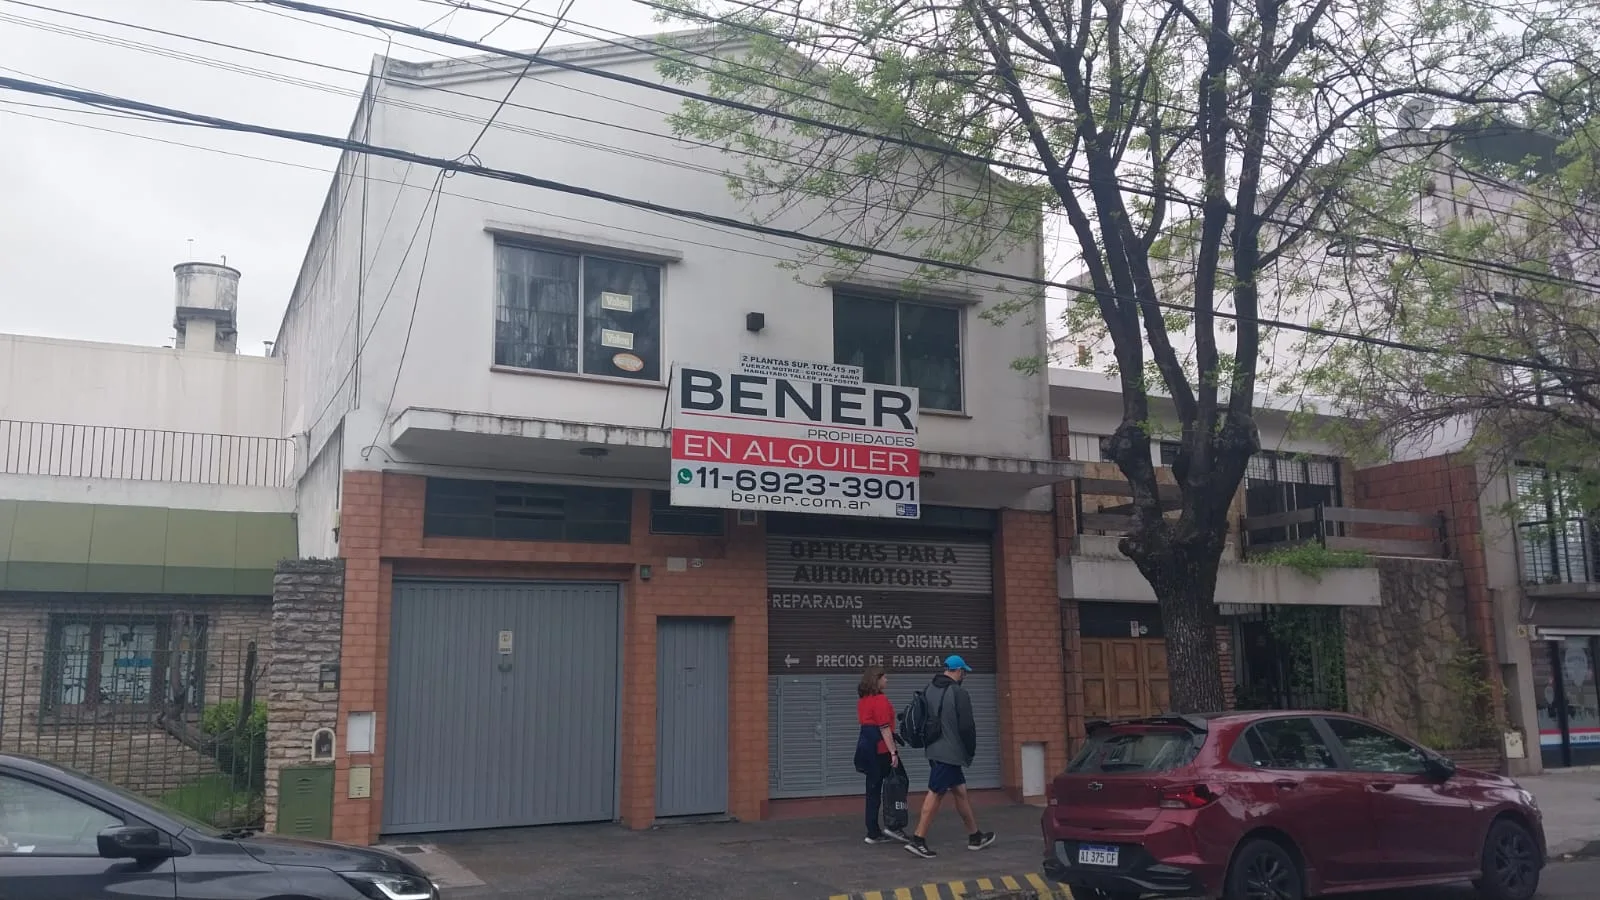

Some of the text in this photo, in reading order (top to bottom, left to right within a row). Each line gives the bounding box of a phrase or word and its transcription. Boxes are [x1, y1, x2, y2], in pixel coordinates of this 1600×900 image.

[741, 362, 770, 370] FUERZA
[750, 356, 789, 366] PLANTAS
[791, 360, 810, 369] SUP.
[743, 368, 788, 377] HABILITADO
[790, 373, 816, 381] TALLER
[681, 367, 914, 431] BENER
[808, 428, 915, 447] PROPIEDADES
[684, 434, 909, 473] EN ALQUILER
[696, 466, 915, 501] 11-6923-3901
[731, 490, 871, 510] bener.com.ar
[790, 540, 958, 564] OPTICAS PARA
[793, 564, 953, 587] AUTOMOTORES
[772, 593, 863, 609] REPARADAS
[851, 614, 913, 629] NUEVAS
[896, 634, 979, 649] ORIGINALES
[816, 655, 942, 668] PRECIOS DE FABRICA
[1090, 851, 1105, 863] 375
